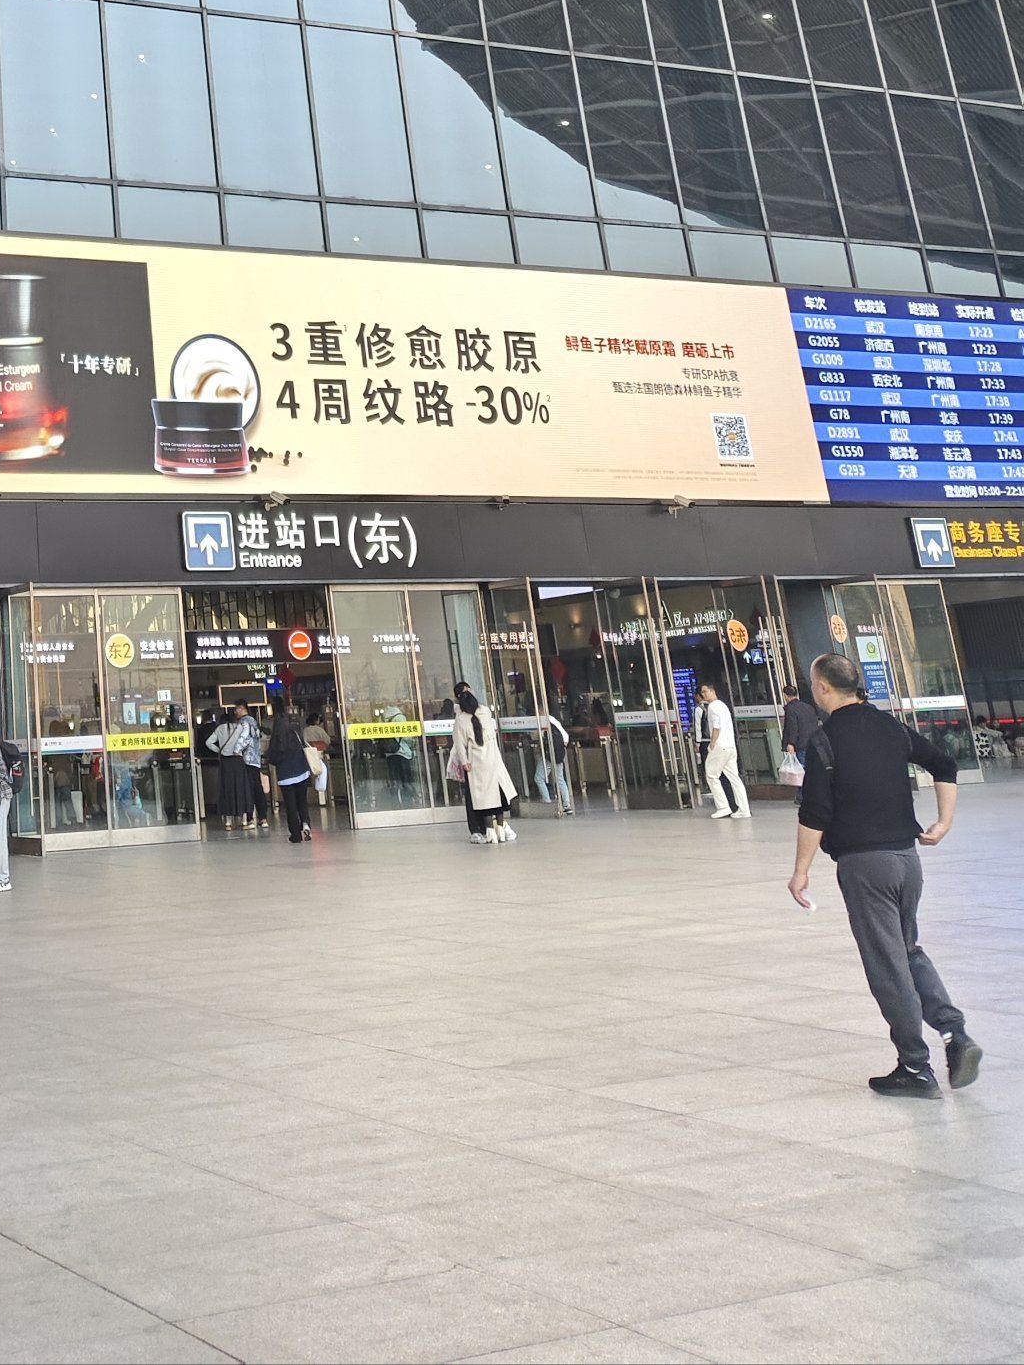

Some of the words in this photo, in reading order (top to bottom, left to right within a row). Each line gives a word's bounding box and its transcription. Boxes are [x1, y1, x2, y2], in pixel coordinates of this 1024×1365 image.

[805, 317, 836, 330] D2165
[969, 327, 993, 338] 17:23
[809, 336, 839, 347] G2055
[972, 344, 997, 354] 17:23
[813, 354, 843, 365] G1009
[977, 361, 1002, 371] 17:28
[4, 380, 33, 392] Cream
[820, 373, 845, 383] G833
[980, 379, 1005, 389] 17:33
[820, 390, 850, 401] G1117
[985, 396, 1009, 406] 17:38
[830, 409, 850, 419] G78
[989, 414, 1013, 423] 17:39
[828, 427, 860, 438] D2891
[994, 431, 1018, 442] 17:41
[832, 446, 863, 456] G1550
[997, 449, 1022, 459] 17:43
[839, 465, 865, 476] G293
[948, 521, 1020, 543] 商务座专
[237, 512, 418, 569] 进站口(东)
[953, 546, 992, 557] Business
[993, 546, 1017, 557] Class
[239, 552, 302, 568] Entrance
[108, 642, 132, 660] 东2
